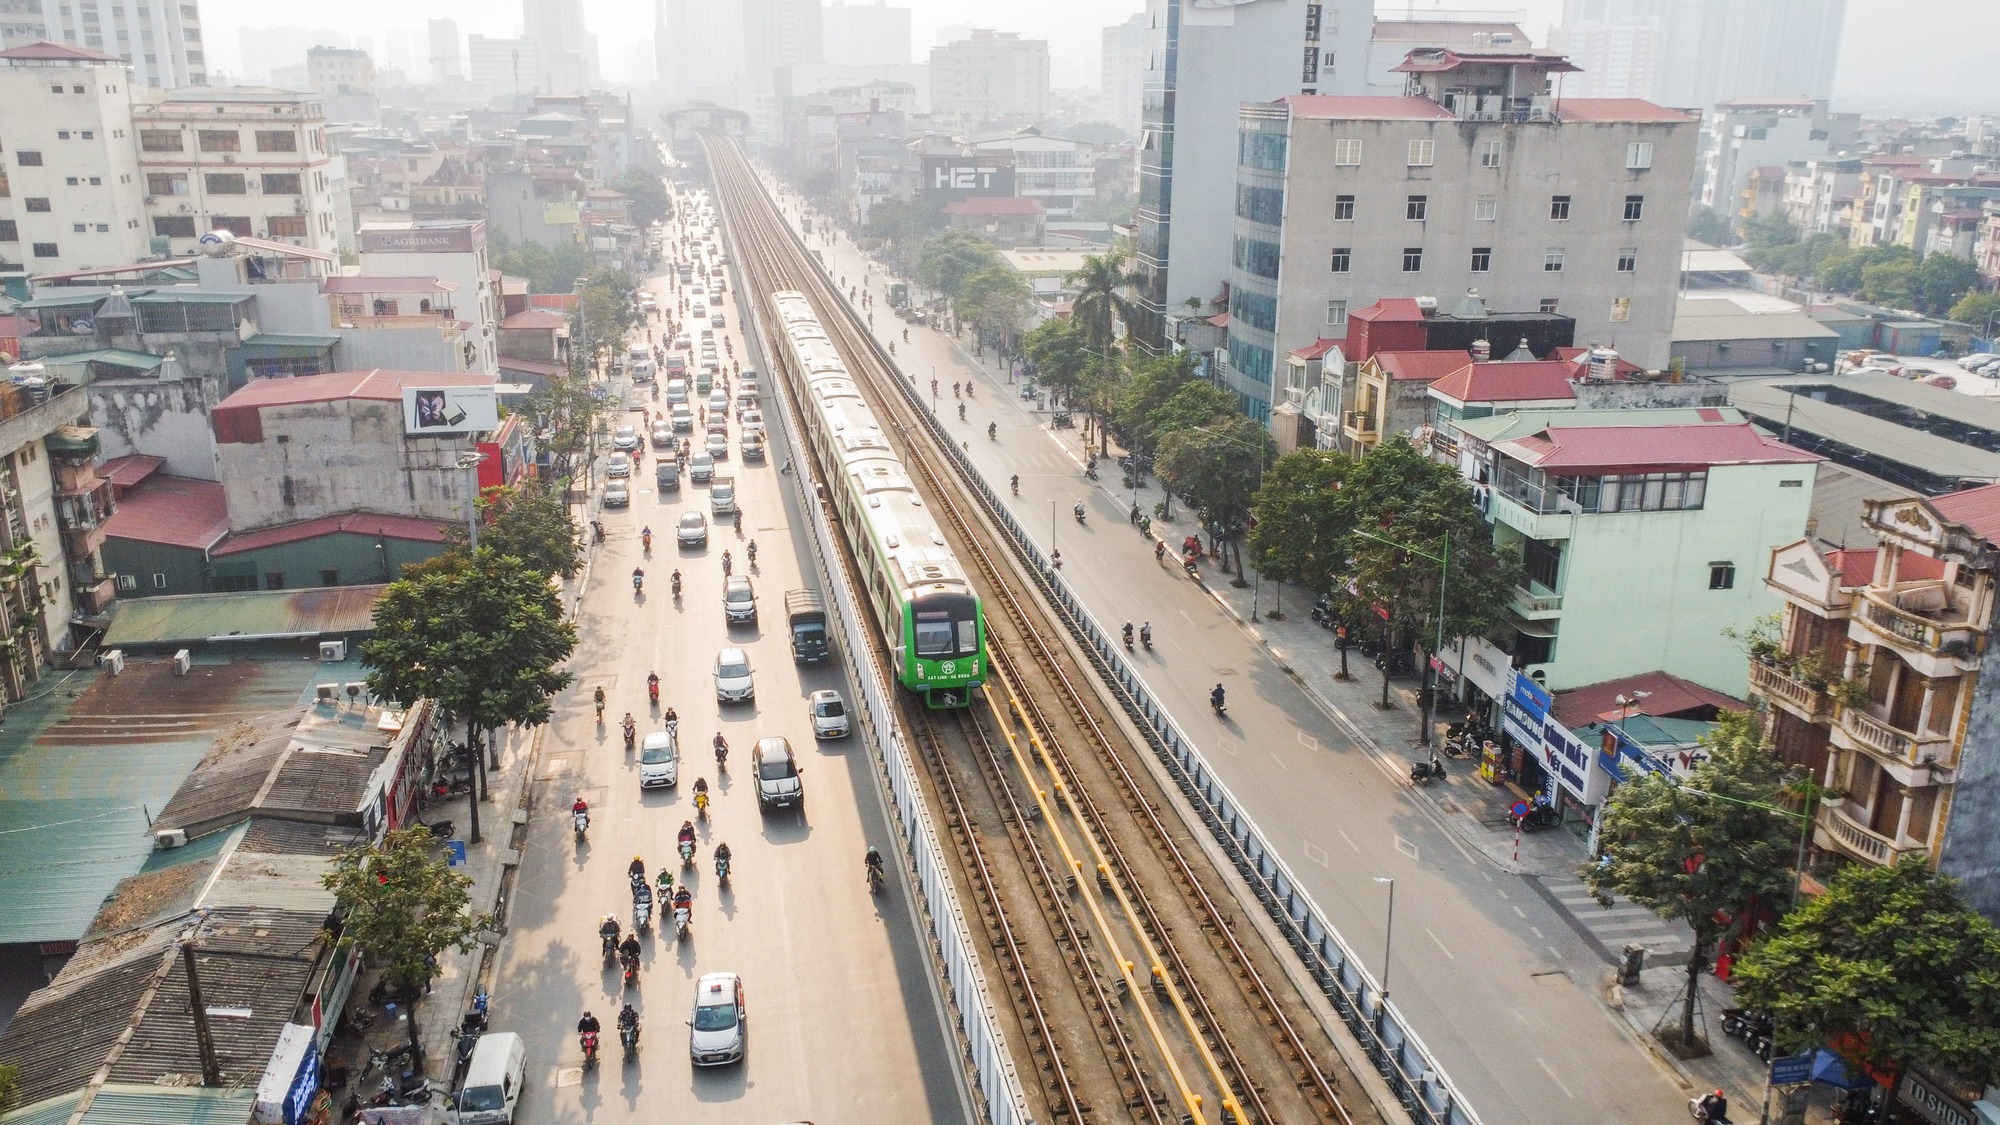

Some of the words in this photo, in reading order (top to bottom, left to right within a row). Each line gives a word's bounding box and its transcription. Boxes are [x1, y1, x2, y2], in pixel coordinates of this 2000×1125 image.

[935, 167, 997, 188] H2T
[393, 237, 450, 246] AGRIBANK
[1505, 699, 1544, 739] SAMSUNG
[1543, 722, 1566, 755] KÍNH
